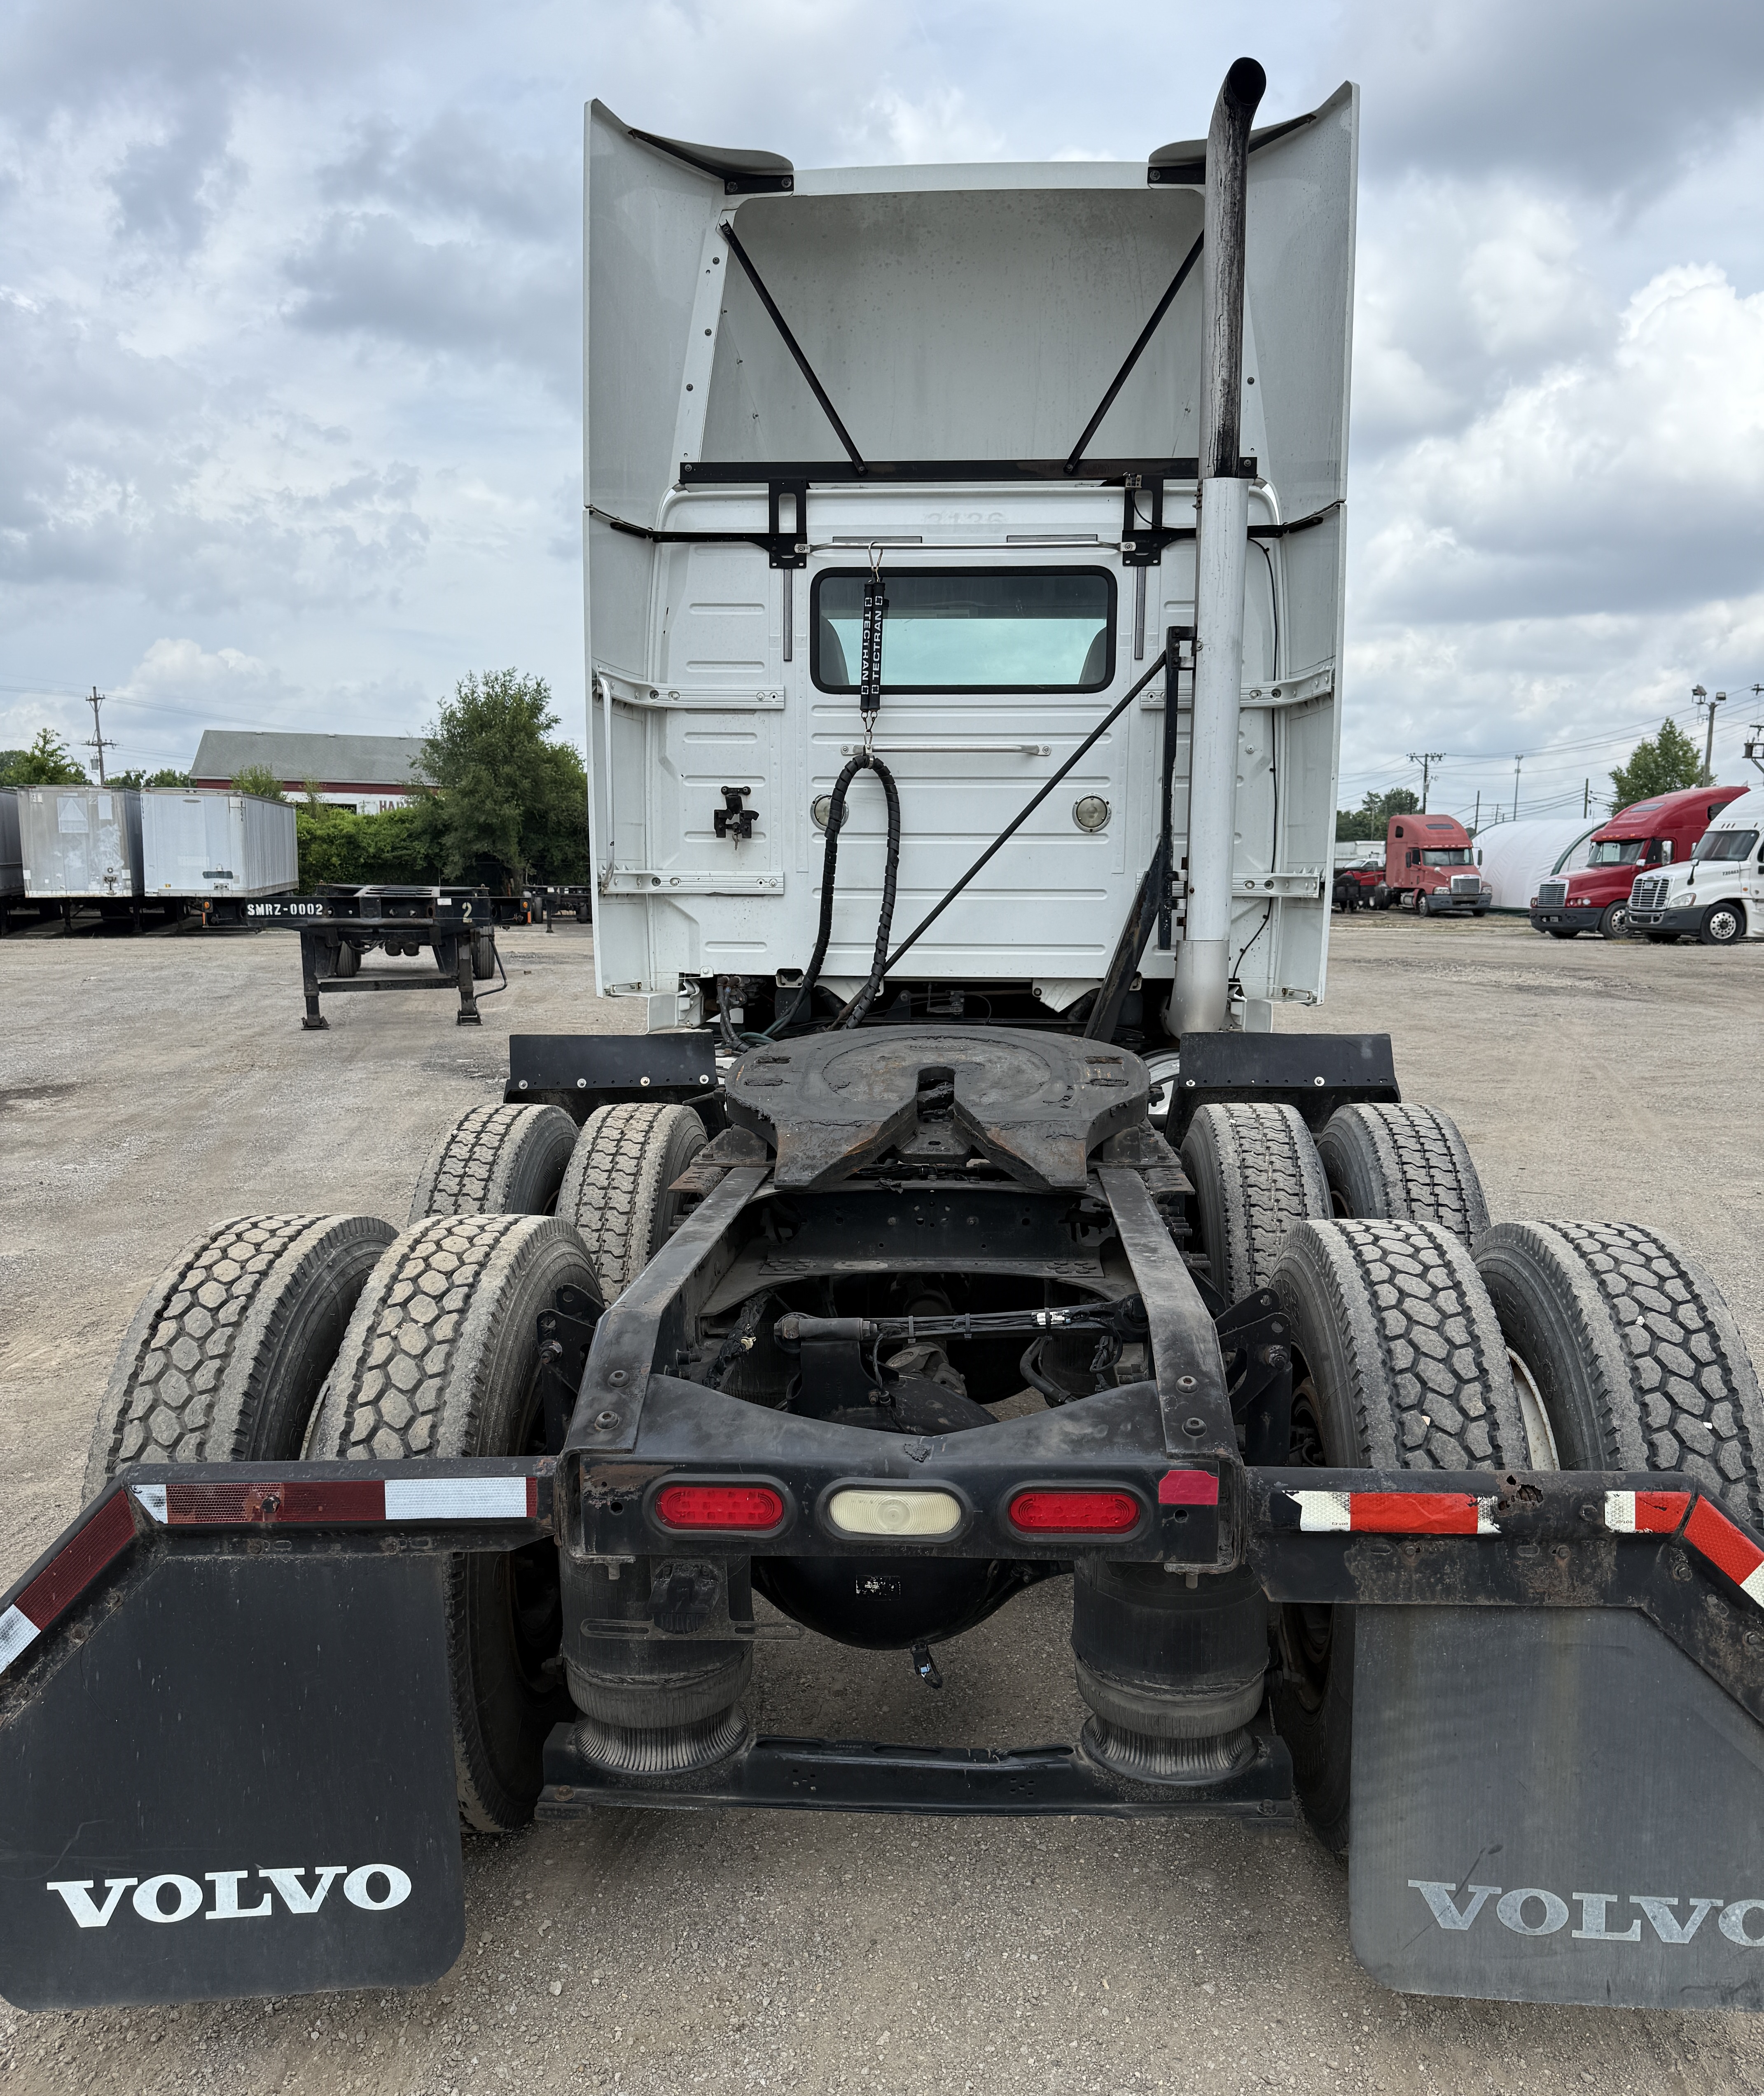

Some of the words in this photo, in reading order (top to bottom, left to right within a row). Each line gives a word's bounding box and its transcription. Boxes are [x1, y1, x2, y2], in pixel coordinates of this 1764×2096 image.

[927, 512, 1004, 534] 3136
[862, 611, 871, 680] TECTRAN
[872, 610, 882, 680] TECTRAN
[247, 904, 323, 916] SMRZ-0002
[462, 902, 472, 923] 2
[47, 1863, 412, 1928] VOLVO
[1408, 1879, 1764, 1947] VOLVO
